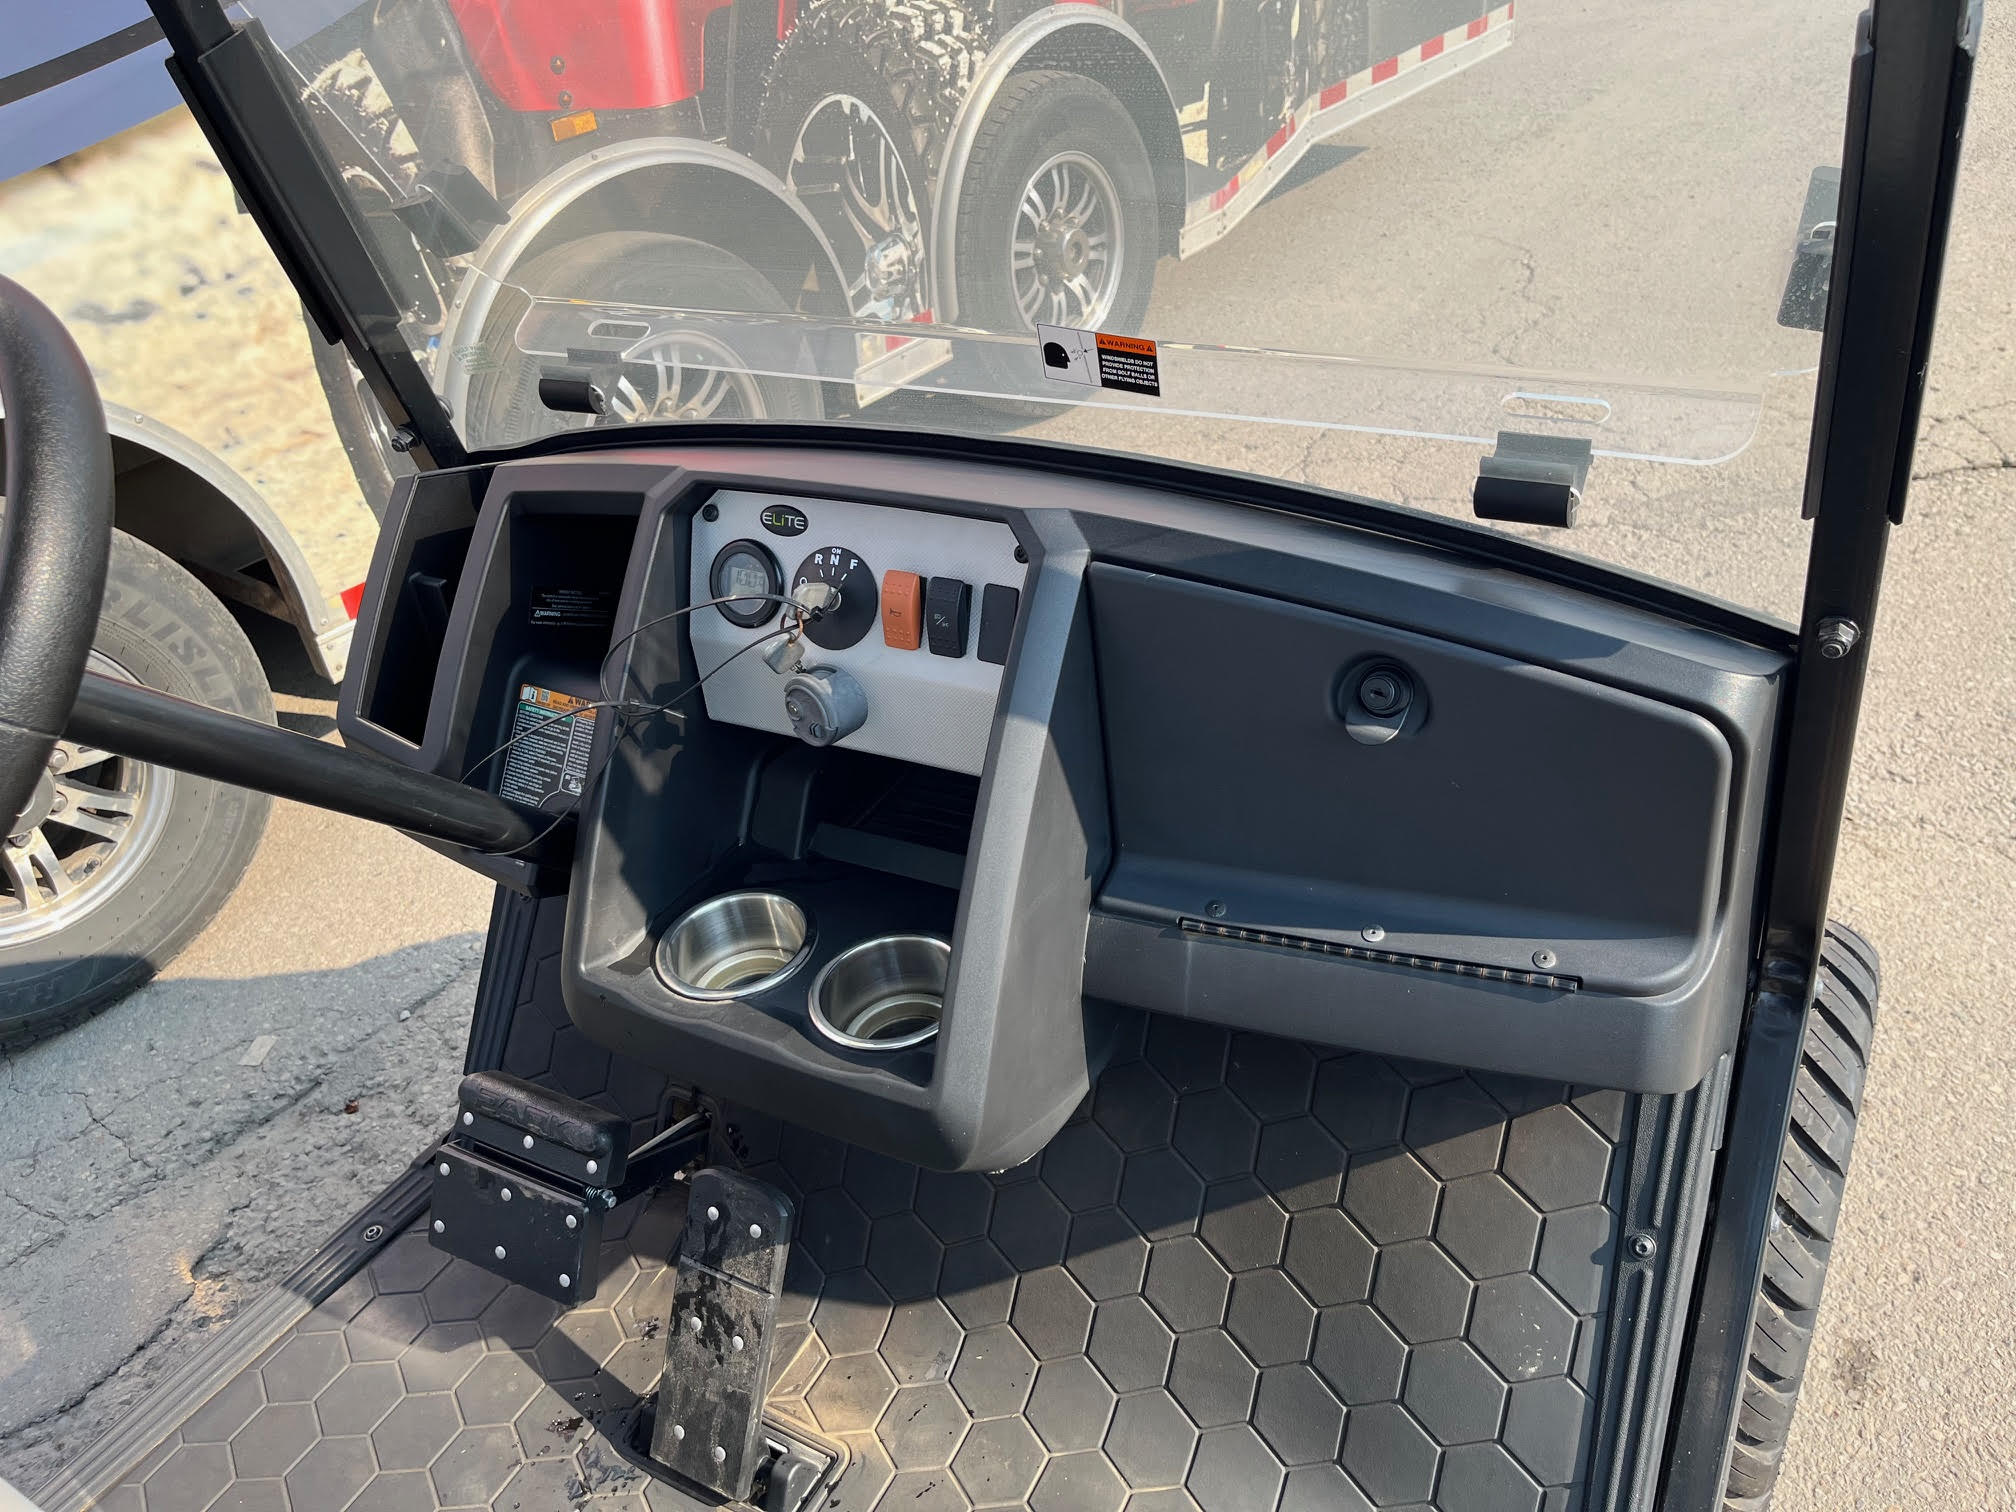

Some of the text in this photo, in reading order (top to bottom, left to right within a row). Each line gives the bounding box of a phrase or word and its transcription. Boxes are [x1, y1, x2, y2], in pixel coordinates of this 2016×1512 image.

[1107, 340, 1145, 350] WARNING
[1101, 354, 1134, 364] WINDSHIELDS
[1102, 360, 1155, 374] PROVIDE PROTECTION
[1131, 371, 1147, 379] BALLS
[1118, 376, 1136, 384] FLYING
[1136, 378, 1158, 387] OBJECTS
[831, 547, 842, 555] ON
[814, 553, 859, 570] R N F
